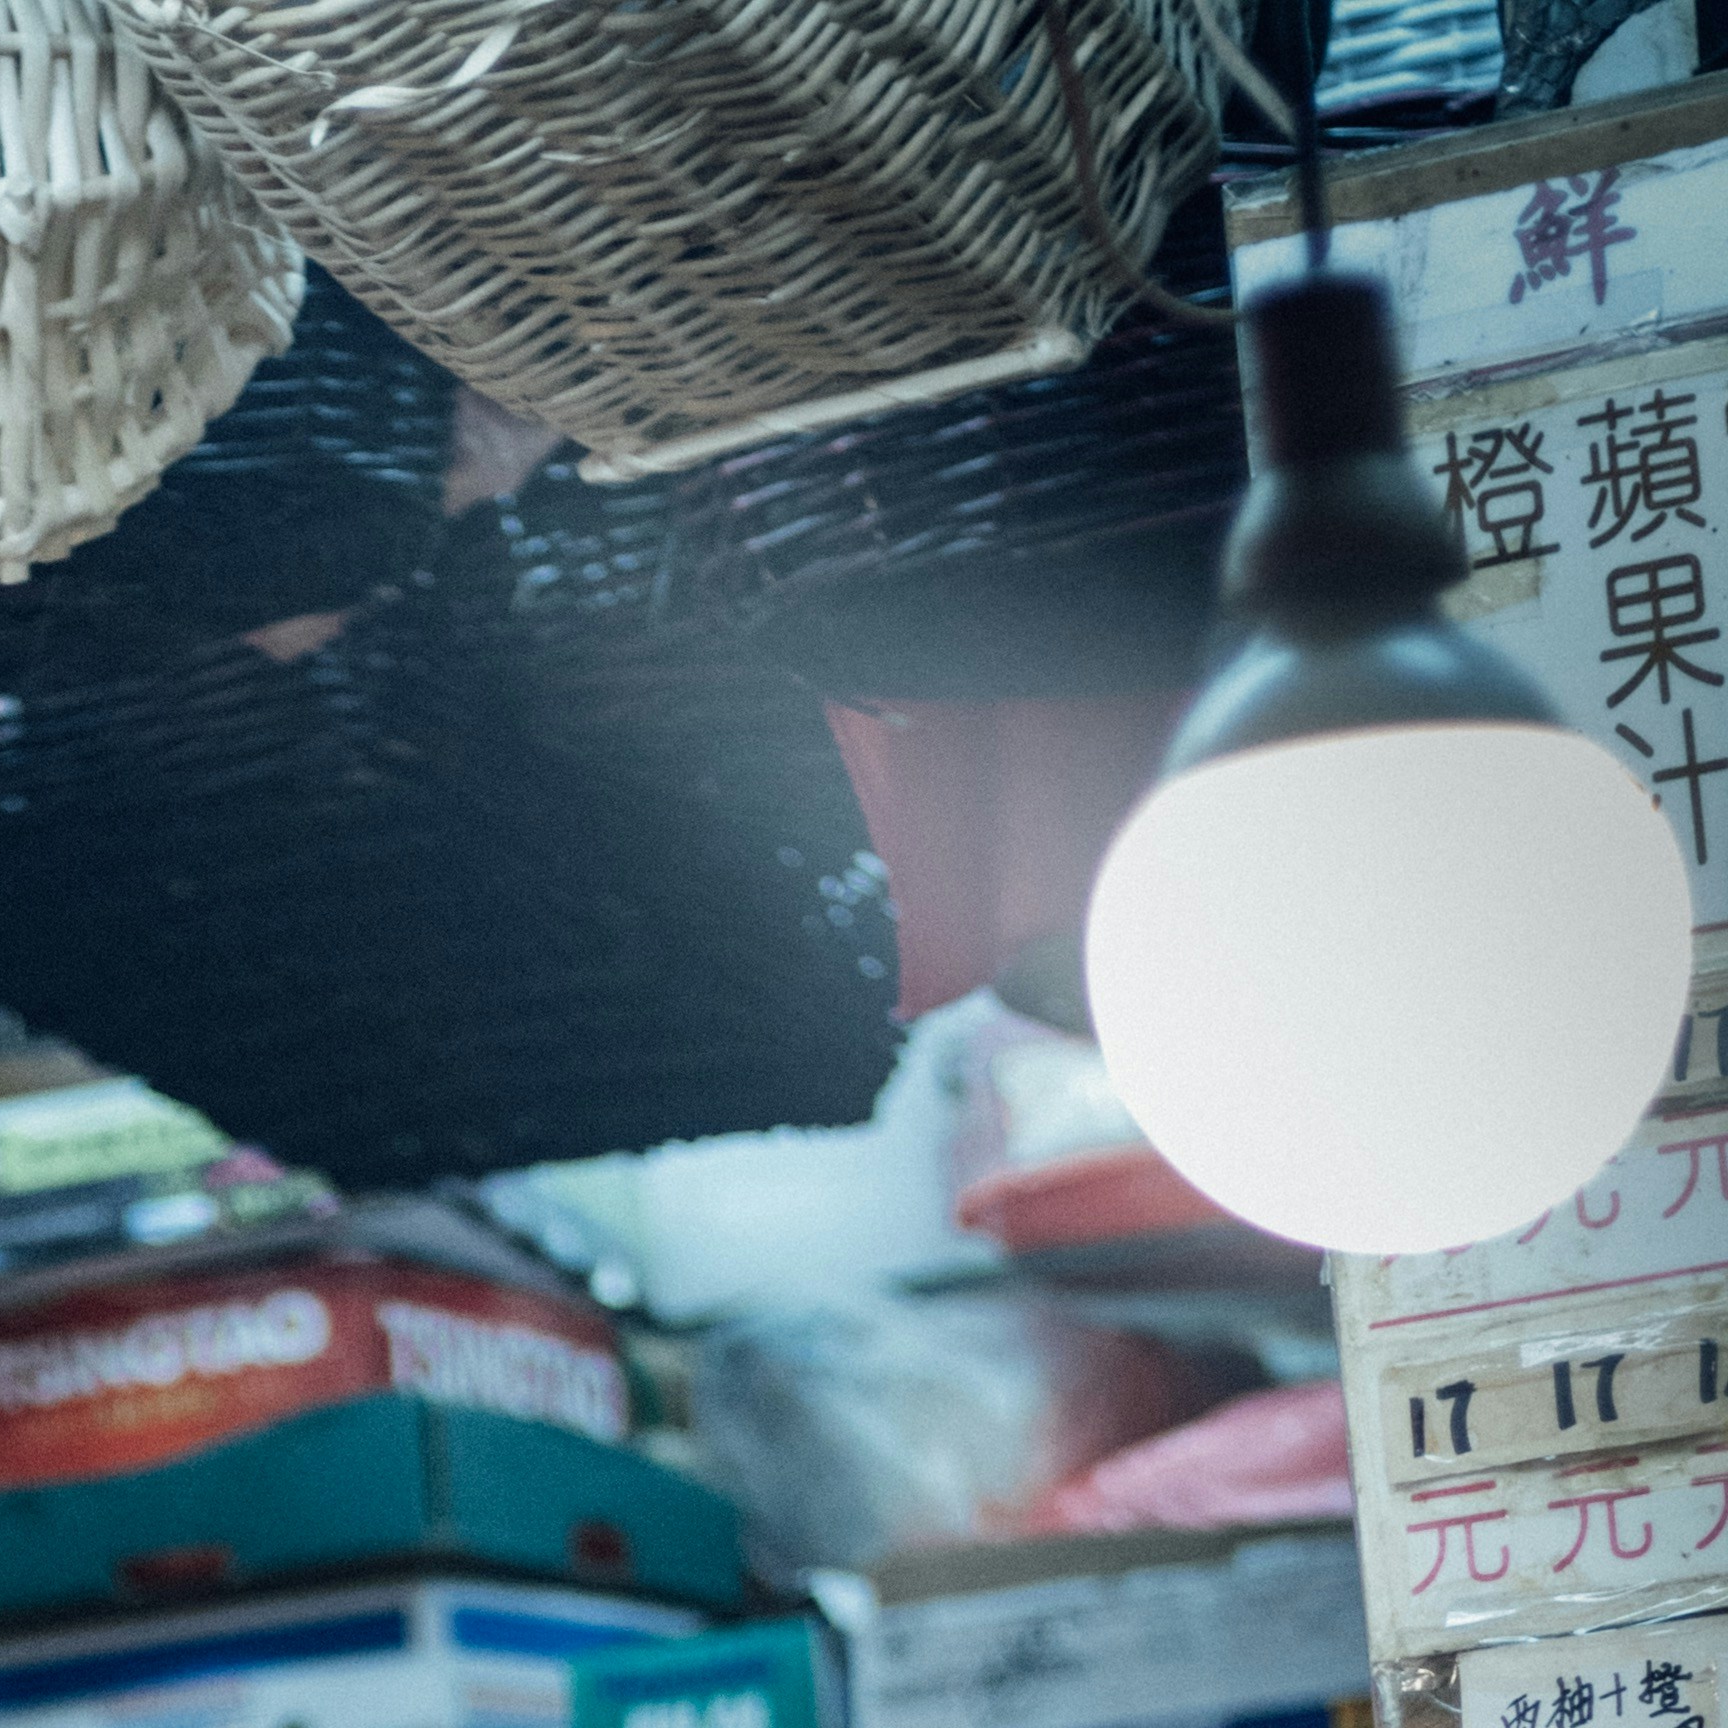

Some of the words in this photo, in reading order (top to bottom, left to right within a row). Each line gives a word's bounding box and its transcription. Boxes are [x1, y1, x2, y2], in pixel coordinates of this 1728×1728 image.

[1508, 165, 1638, 306] 鮮
[1433, 421, 1562, 571] 橙
[1576, 388, 1728, 867] 蘋果汁
[1409, 1380, 1477, 1459] 17
[1552, 1352, 1626, 1430] 17
[1405, 1480, 1511, 1596] 元
[1548, 1456, 1653, 1574] 元
